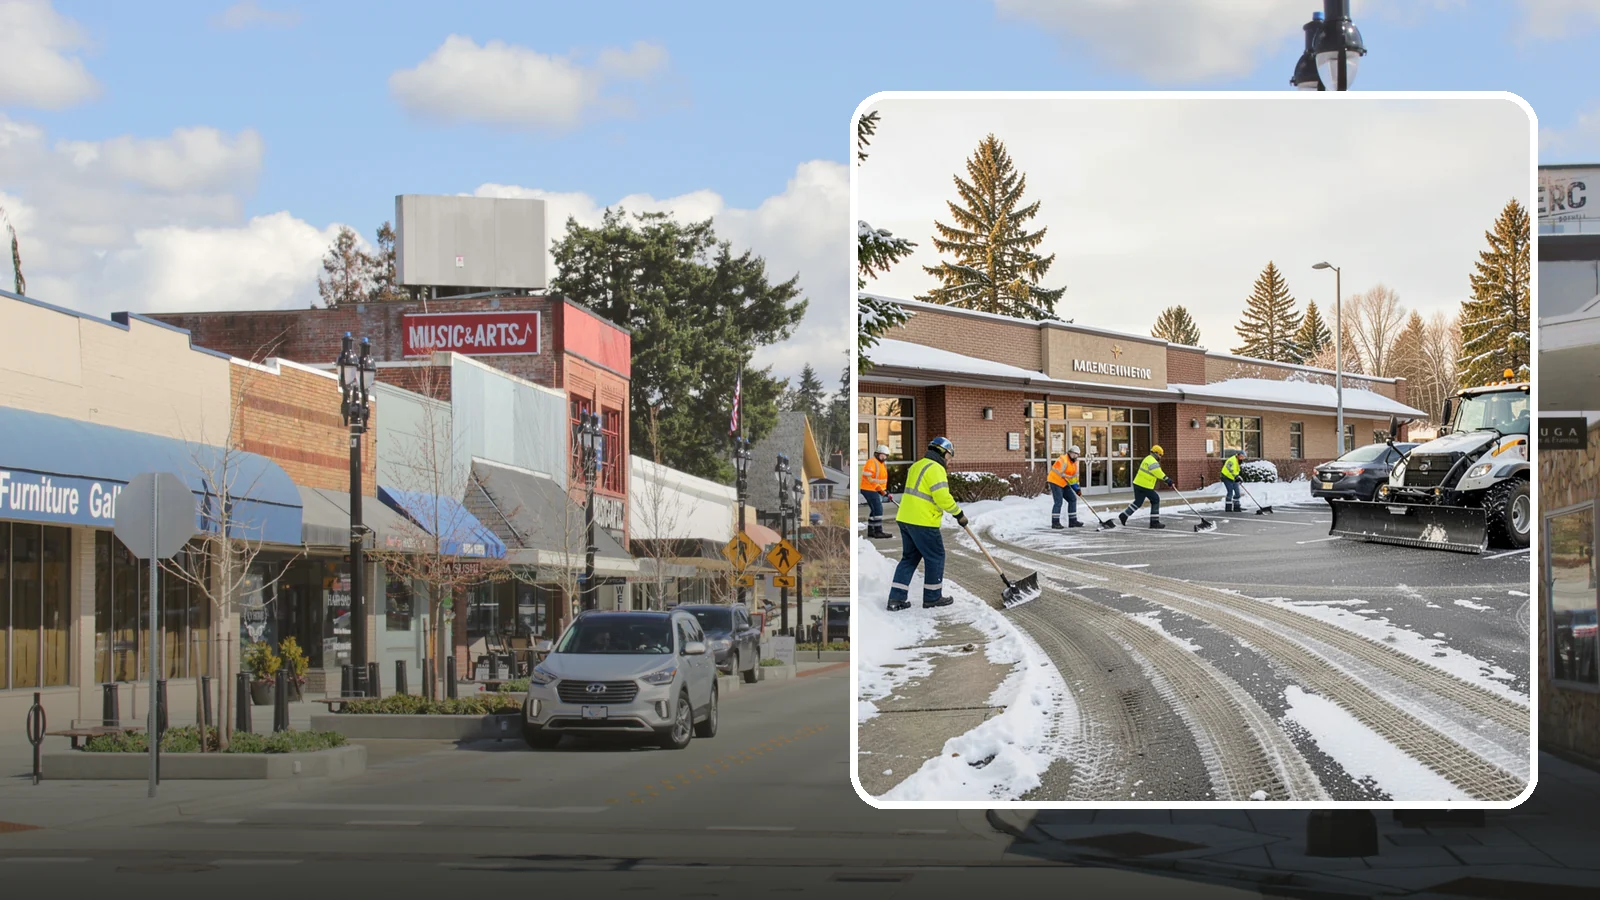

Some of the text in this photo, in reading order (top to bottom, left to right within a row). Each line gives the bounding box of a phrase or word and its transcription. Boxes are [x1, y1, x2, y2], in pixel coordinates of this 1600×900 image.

[1540, 427, 1577, 437] UGA
[0, 471, 122, 519] Furniture Gal
